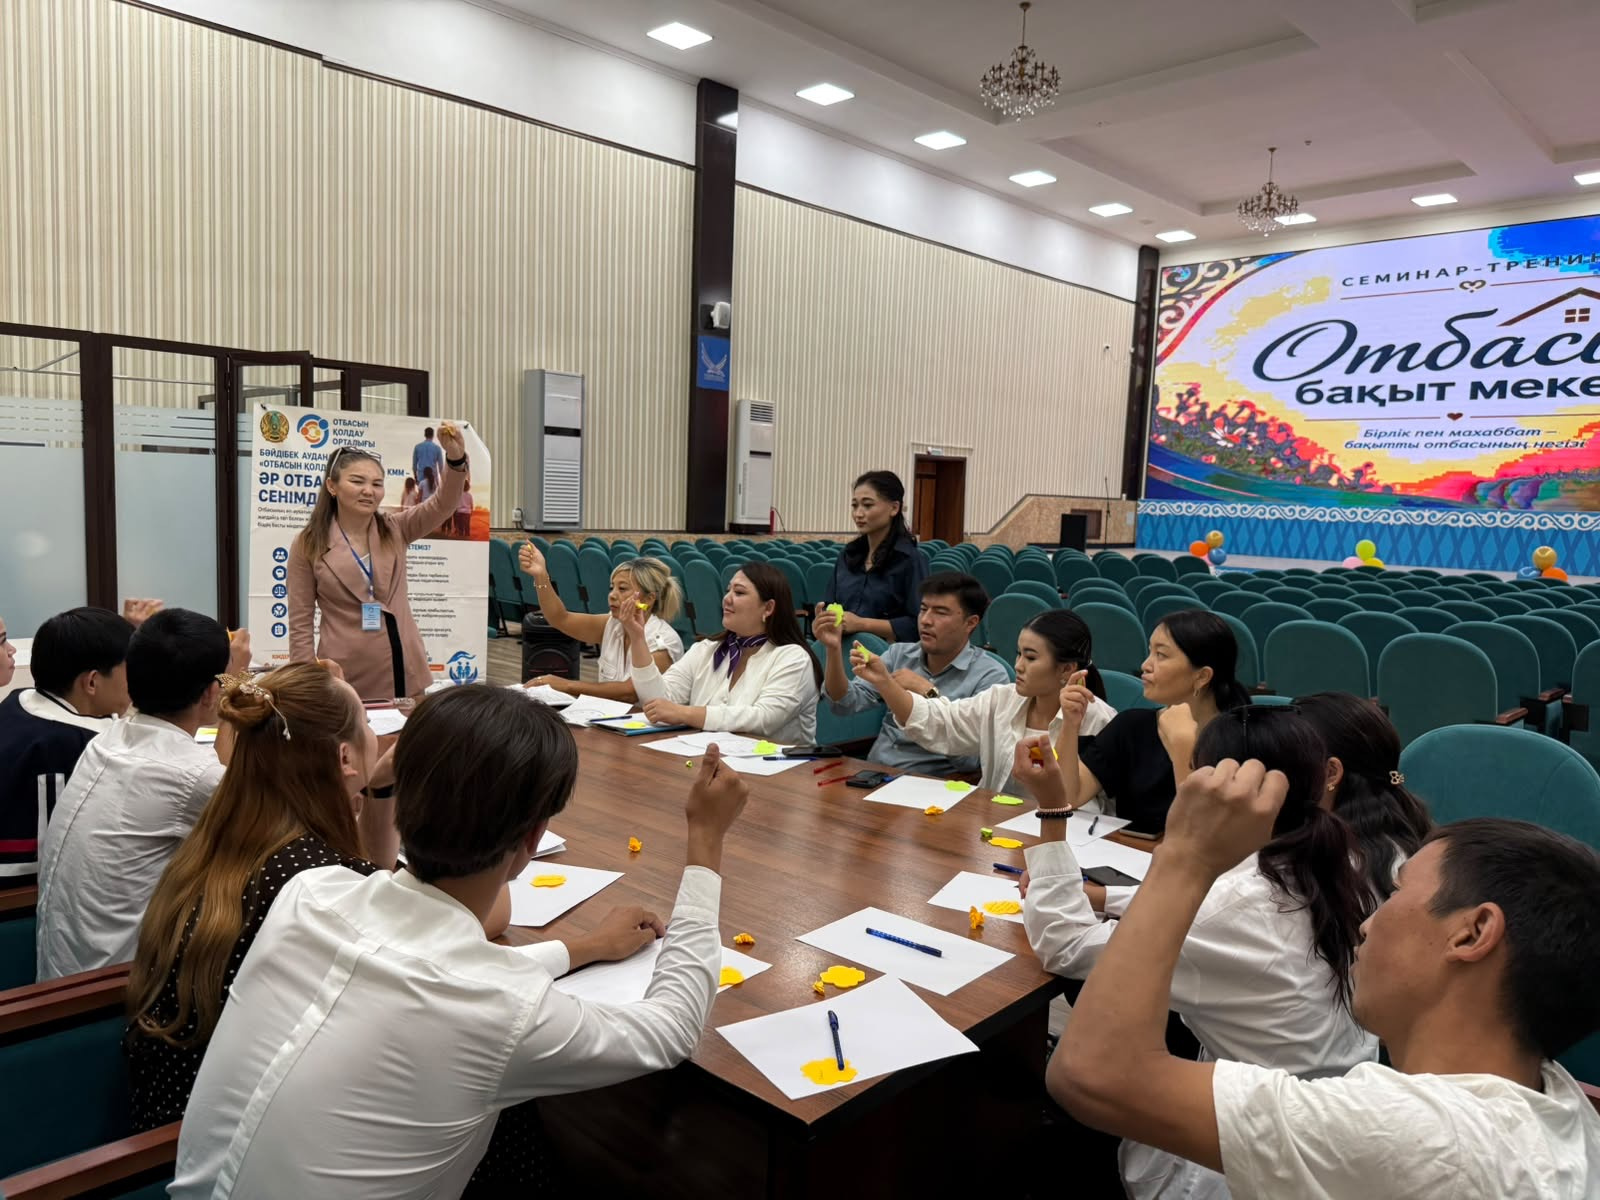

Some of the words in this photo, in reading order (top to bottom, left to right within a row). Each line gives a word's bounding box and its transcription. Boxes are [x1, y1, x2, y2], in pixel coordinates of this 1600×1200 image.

[1295, 379, 1456, 407] бақыт
[333, 418, 369, 428] ОТБАСЫН
[333, 428, 365, 438] ҚОЛДАУ
[1363, 428, 1412, 440] Бірлік
[1414, 429, 1445, 438] пен
[1448, 427, 1542, 438] махаббат
[332, 438, 376, 448] ОРТАЛЫҒЫ
[1344, 440, 1420, 450] бақытты
[1424, 439, 1529, 450] отбасының
[259, 448, 300, 460] БӘЙДІБЕК
[302, 451, 331, 461] АУДАН
[304, 462, 328, 473] ҚОЛД
[387, 468, 405, 476] КММ
[259, 472, 280, 486] ӘР
[284, 473, 323, 488] ОТБА
[258, 489, 318, 508] СЕНІМД
